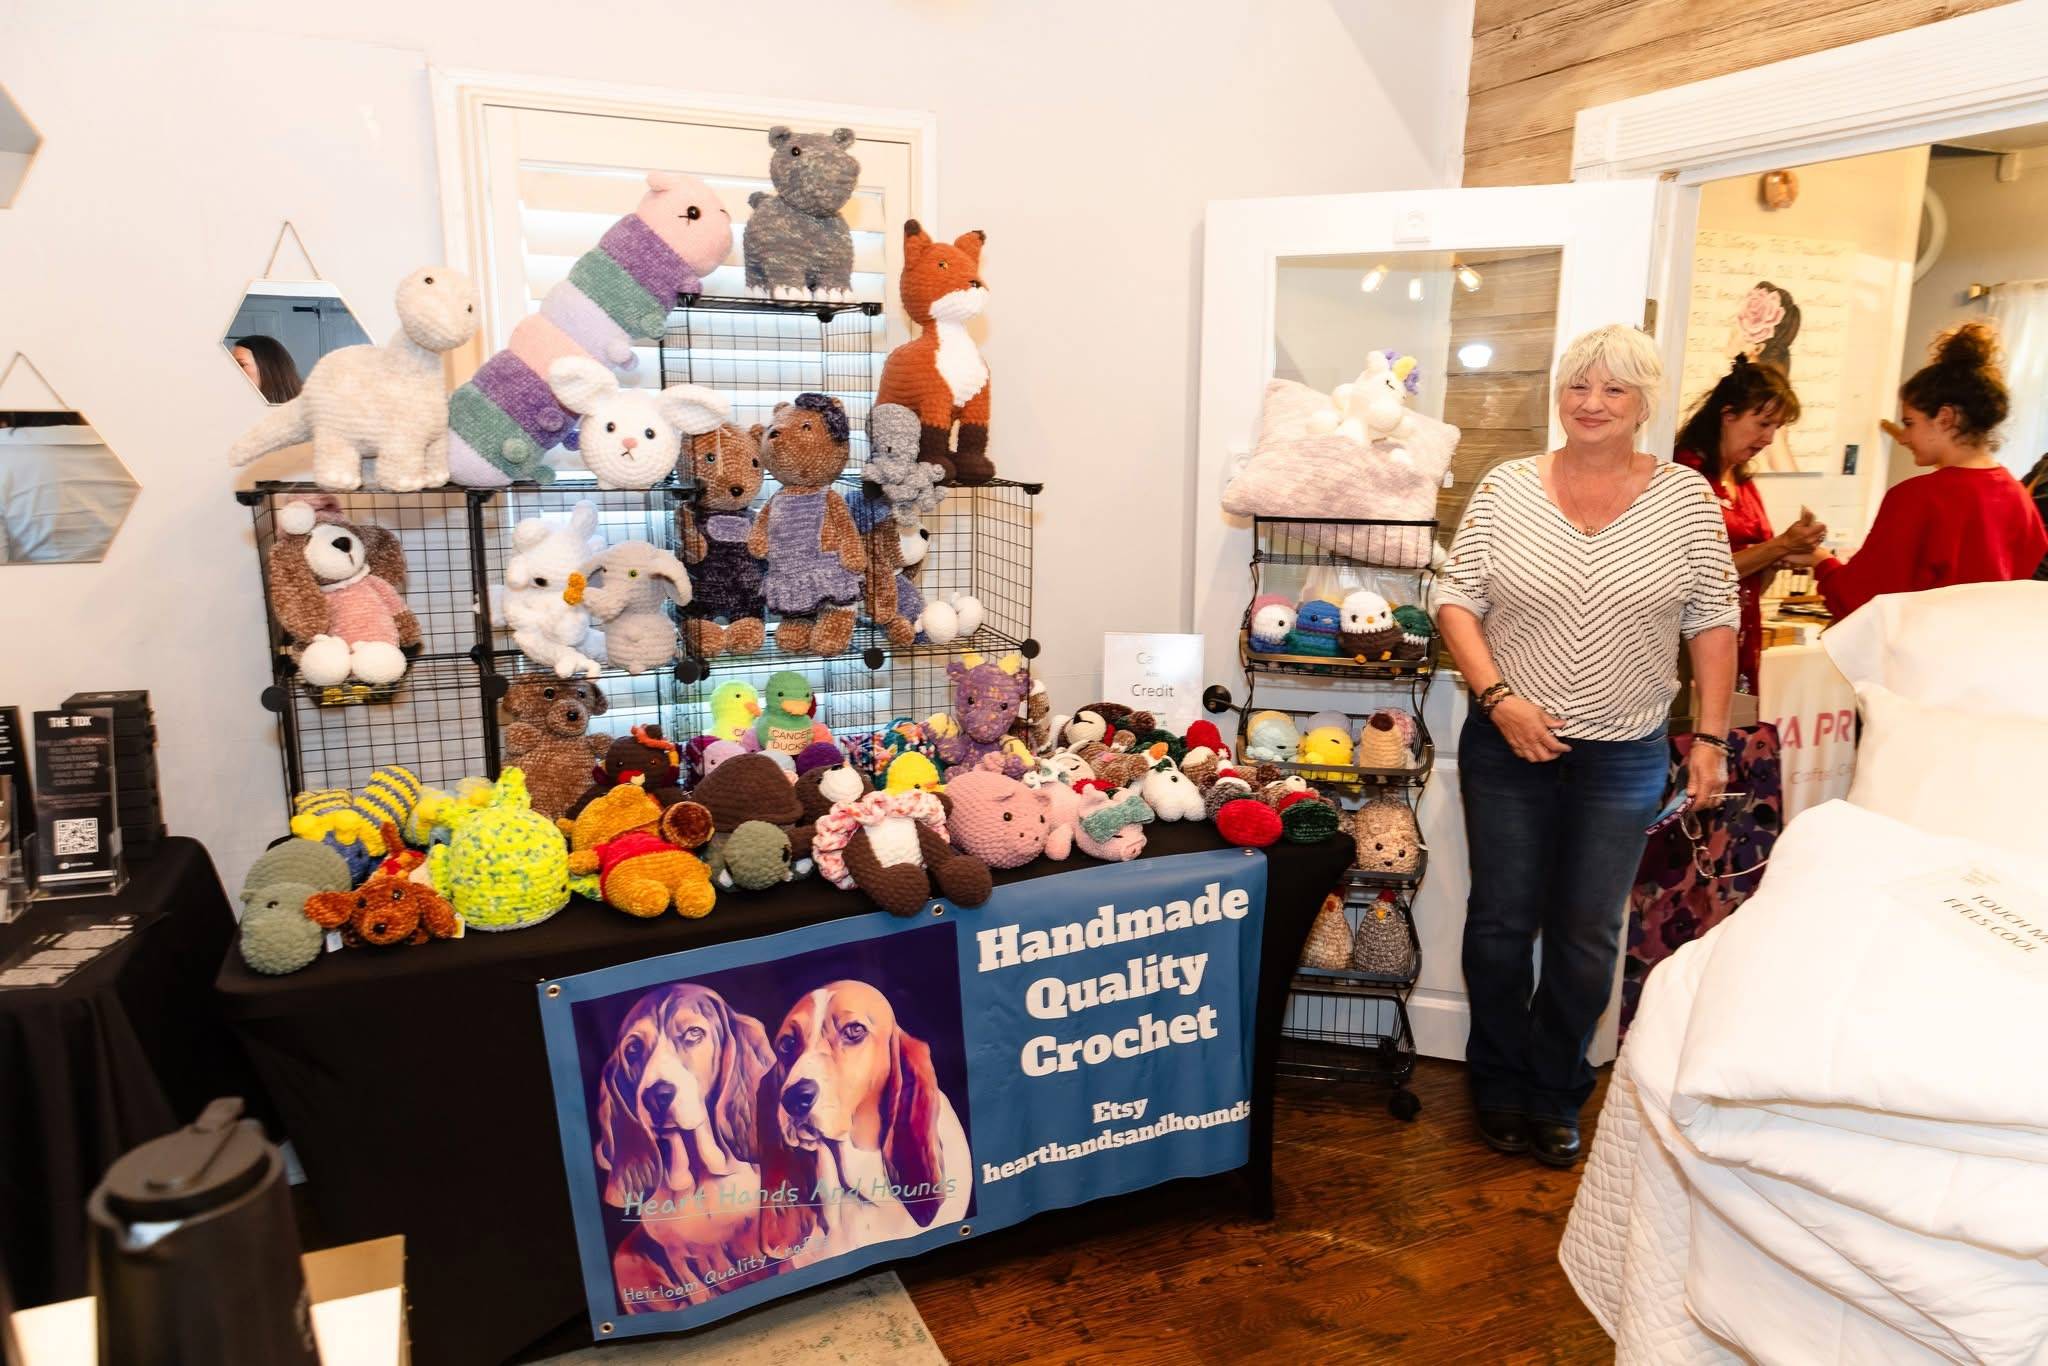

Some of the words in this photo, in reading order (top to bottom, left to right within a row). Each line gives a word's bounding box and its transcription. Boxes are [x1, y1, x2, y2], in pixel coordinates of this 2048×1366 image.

[1131, 684, 1175, 697] Credit
[48, 716, 70, 728] THE
[976, 882, 1250, 972] Handmade
[1971, 895, 2033, 928] TOUCH
[1025, 953, 1209, 1019] Quality
[1021, 1004, 1218, 1077] Crochet
[1092, 1098, 1149, 1123] Etsy
[982, 1100, 1251, 1184] hearthandsandhounds
[624, 1188, 707, 1216] Heart
[719, 1178, 799, 1204] Hands
[810, 1179, 864, 1202] And
[872, 1175, 957, 1199] Hounds
[623, 1281, 699, 1302] Heirloom
[704, 1254, 768, 1284] Quality
